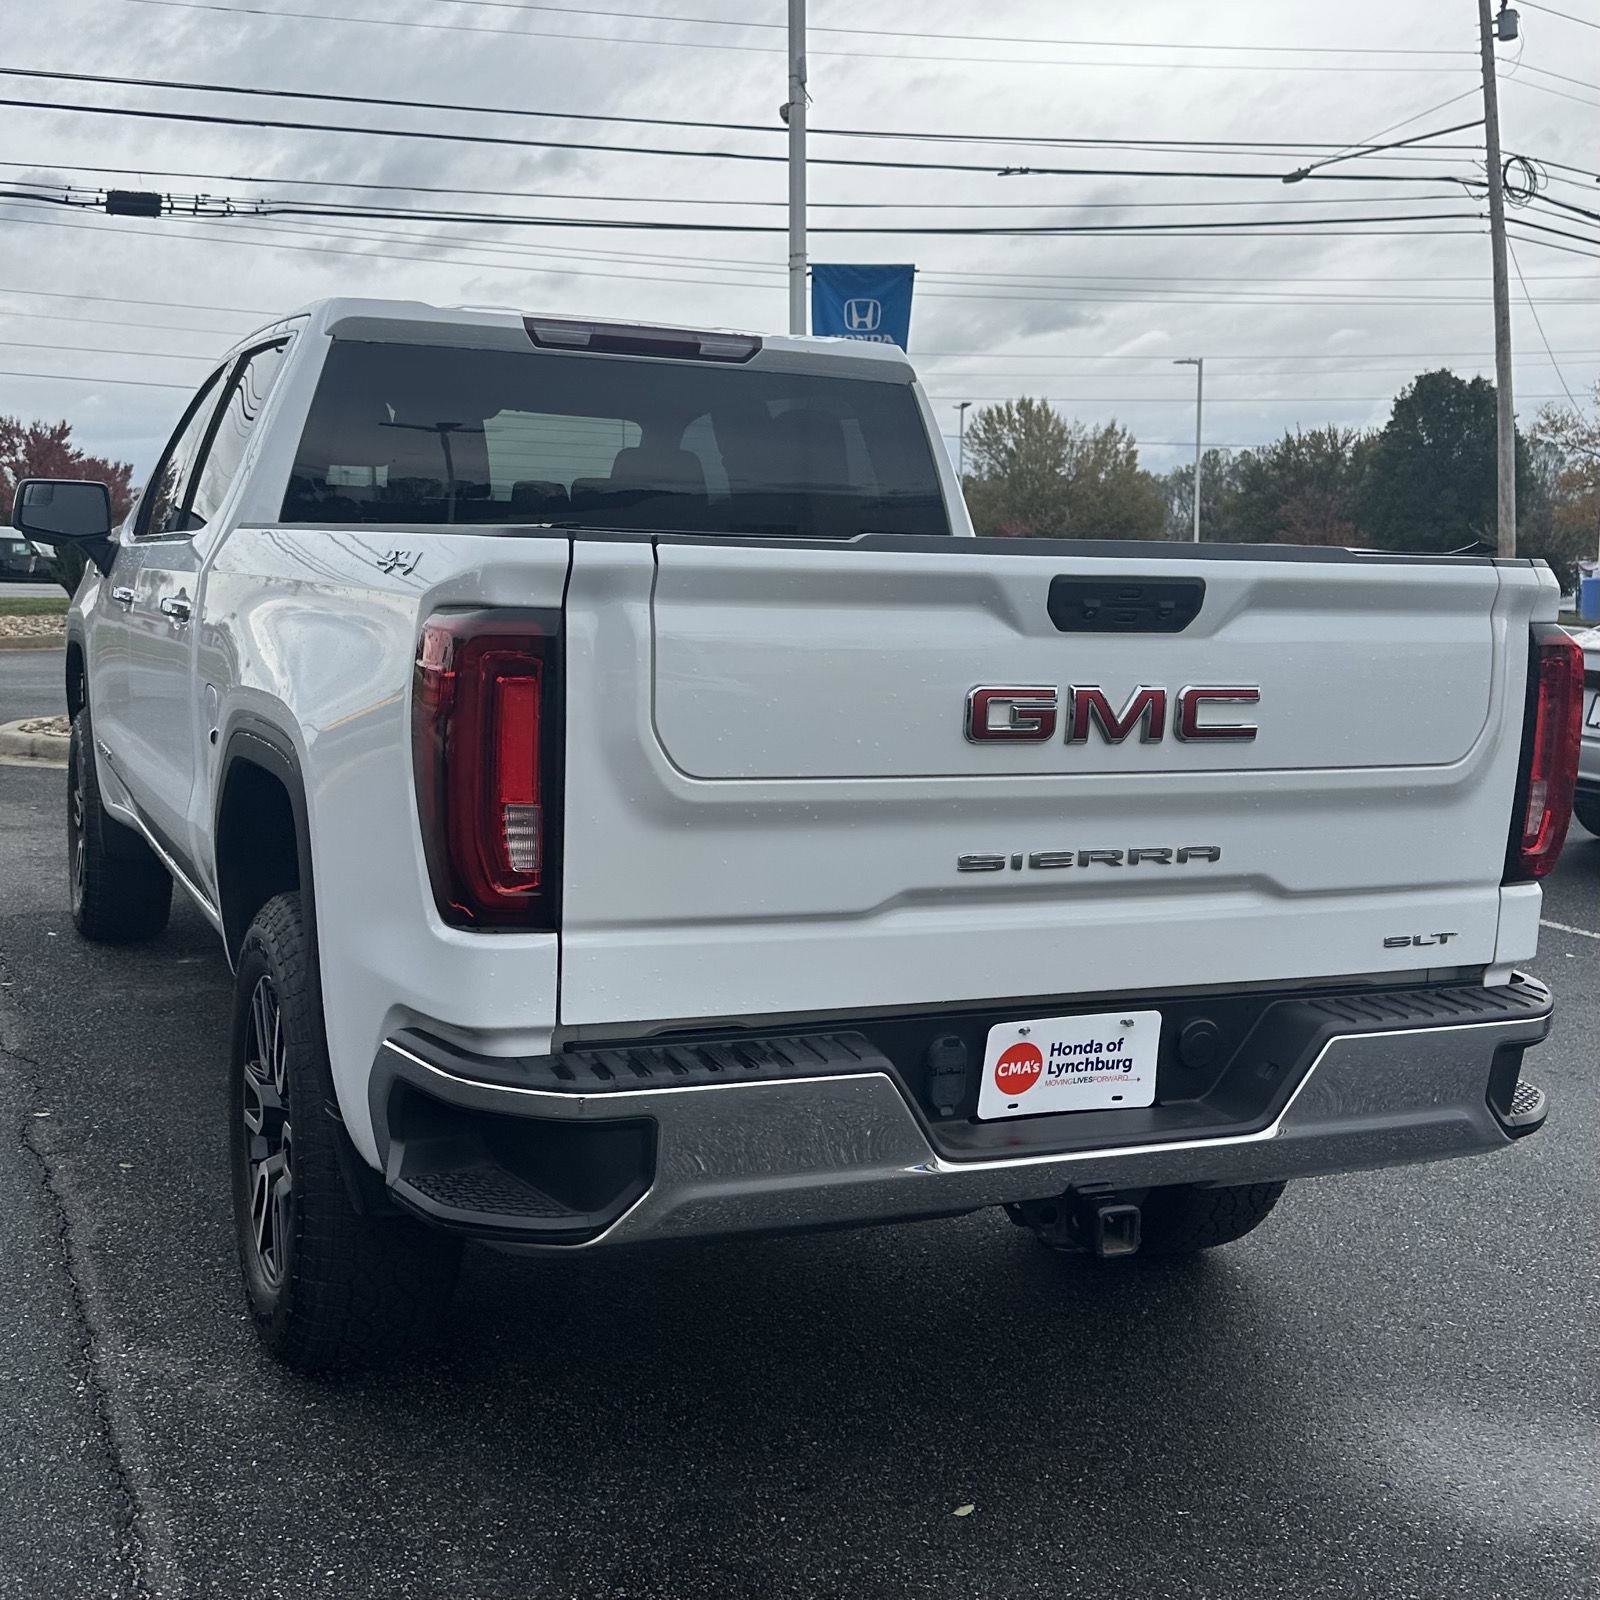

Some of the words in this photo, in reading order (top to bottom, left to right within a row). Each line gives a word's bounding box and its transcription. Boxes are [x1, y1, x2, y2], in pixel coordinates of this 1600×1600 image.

[963, 684, 1261, 745] GMC
[957, 846, 1222, 874] SIERRA
[1383, 932, 1459, 948] SLT
[1050, 1039, 1103, 1058] Honda
[1106, 1037, 1125, 1052] of
[997, 1059, 1041, 1077] CMA's
[1047, 1056, 1133, 1078] Lynchburg
